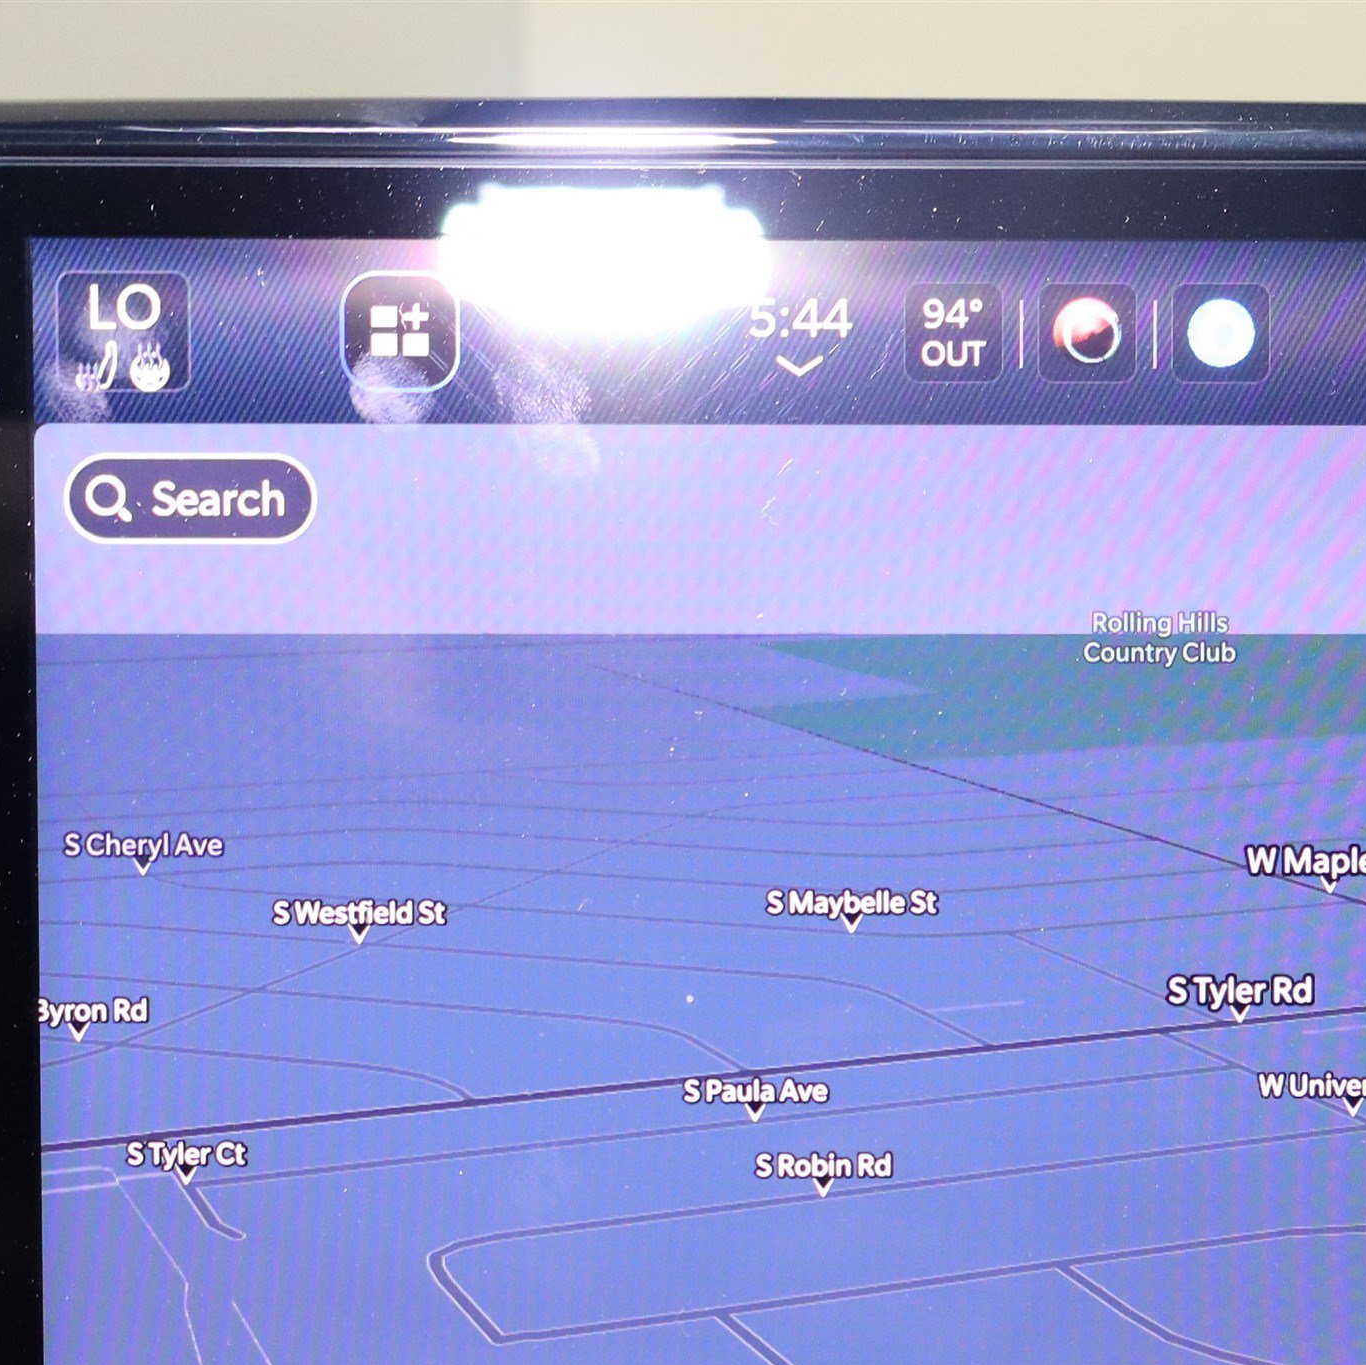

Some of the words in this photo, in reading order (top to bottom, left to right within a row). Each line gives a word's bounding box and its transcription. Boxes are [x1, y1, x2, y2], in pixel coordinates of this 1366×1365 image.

[87, 282, 163, 332] LO
[749, 298, 853, 338] 5:44
[923, 298, 984, 329] 94°
[921, 339, 986, 367] OUT
[151, 479, 286, 519] Search
[1091, 610, 1173, 638] Rolling
[1177, 610, 1230, 634] Hills
[1083, 641, 1177, 668] Country
[1182, 639, 1237, 664] Club
[64, 834, 81, 858] S
[85, 832, 169, 862] Cheryl
[175, 834, 223, 858] Ave
[1245, 846, 1279, 875] W
[273, 901, 290, 926] S
[294, 899, 413, 926] Westfield
[417, 901, 446, 926] St
[766, 890, 784, 916] S
[788, 889, 906, 919] Maybelle
[911, 890, 937, 915] St
[1166, 976, 1187, 1004] S
[1191, 975, 1267, 1010] Tyler
[1273, 976, 1314, 1005] Rd
[38, 998, 107, 1028] Byron
[113, 997, 148, 1022] Rd
[683, 1079, 701, 1104] S
[704, 1078, 775, 1104] Paula
[783, 1079, 829, 1104] Ave
[1258, 1074, 1286, 1098] W
[126, 1142, 144, 1167] S
[149, 1142, 211, 1171] Tyler
[215, 1142, 247, 1167] Ct
[755, 1154, 773, 1179] S
[776, 1152, 853, 1179] Robin
[857, 1153, 893, 1179] Rd
